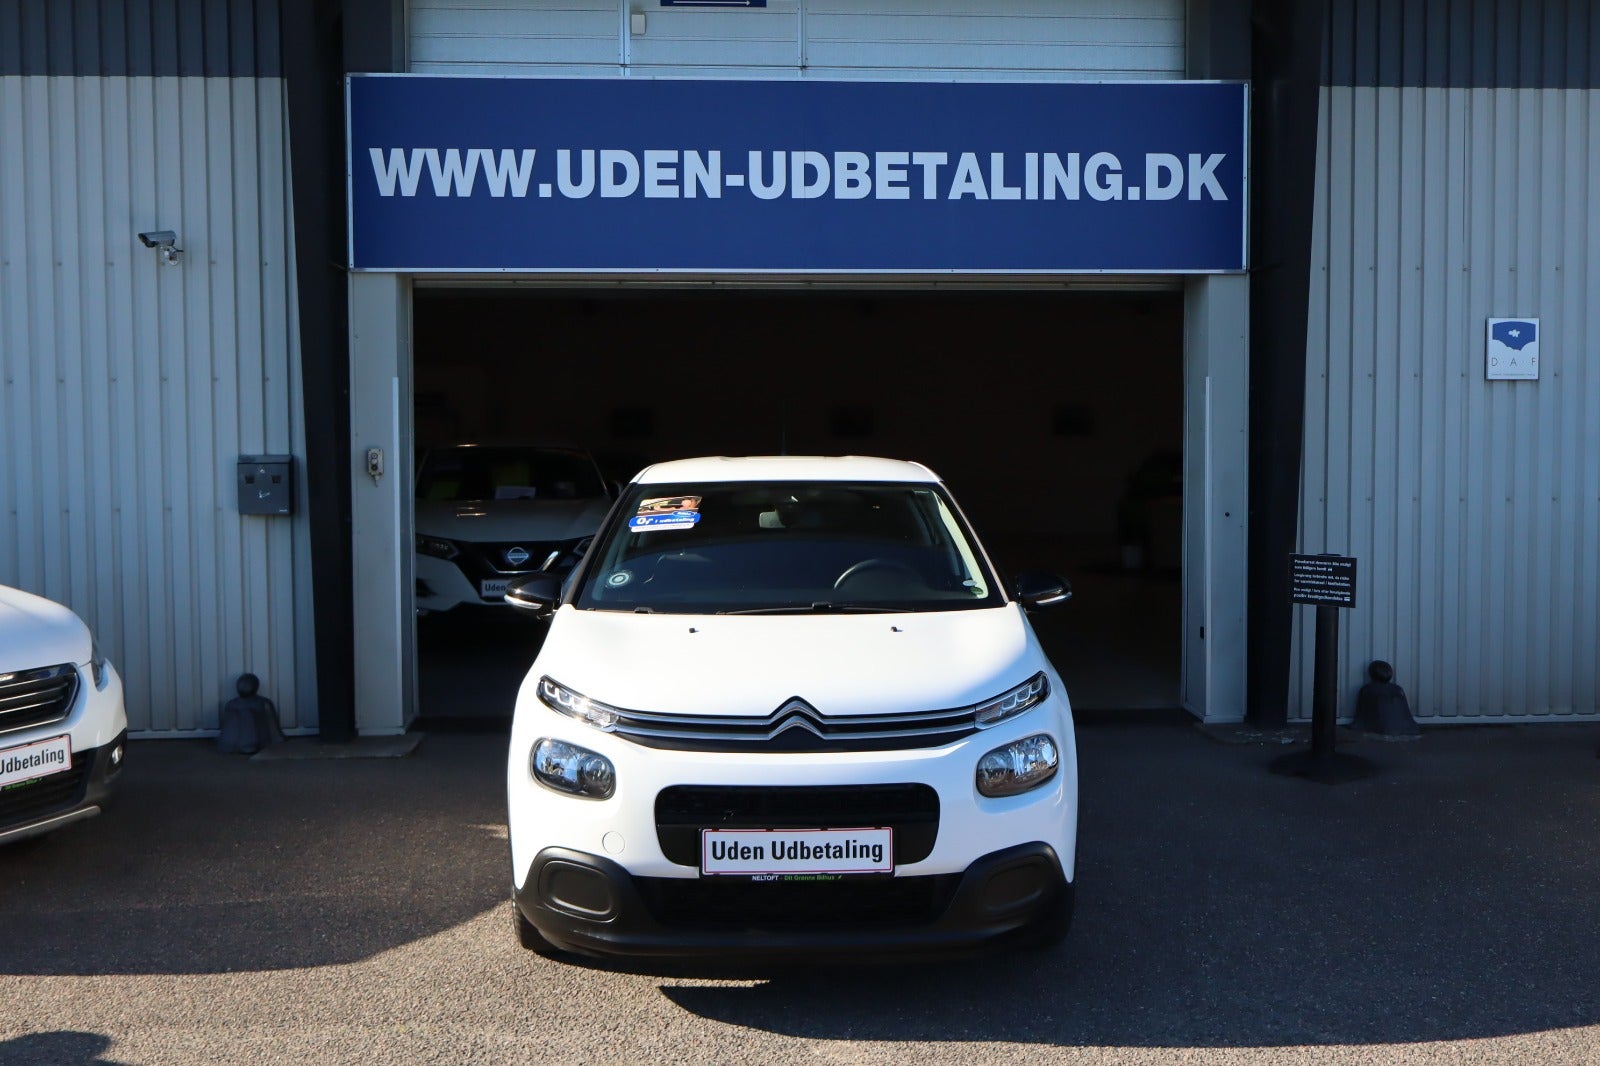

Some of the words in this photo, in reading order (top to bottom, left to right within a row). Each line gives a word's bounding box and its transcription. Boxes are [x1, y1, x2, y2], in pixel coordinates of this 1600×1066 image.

[368, 147, 1229, 202] WWW.UDEN-UDBETALING.DK
[485, 583, 506, 592] Uden
[712, 841, 764, 860] Uden
[771, 839, 883, 863] Udbetaling
